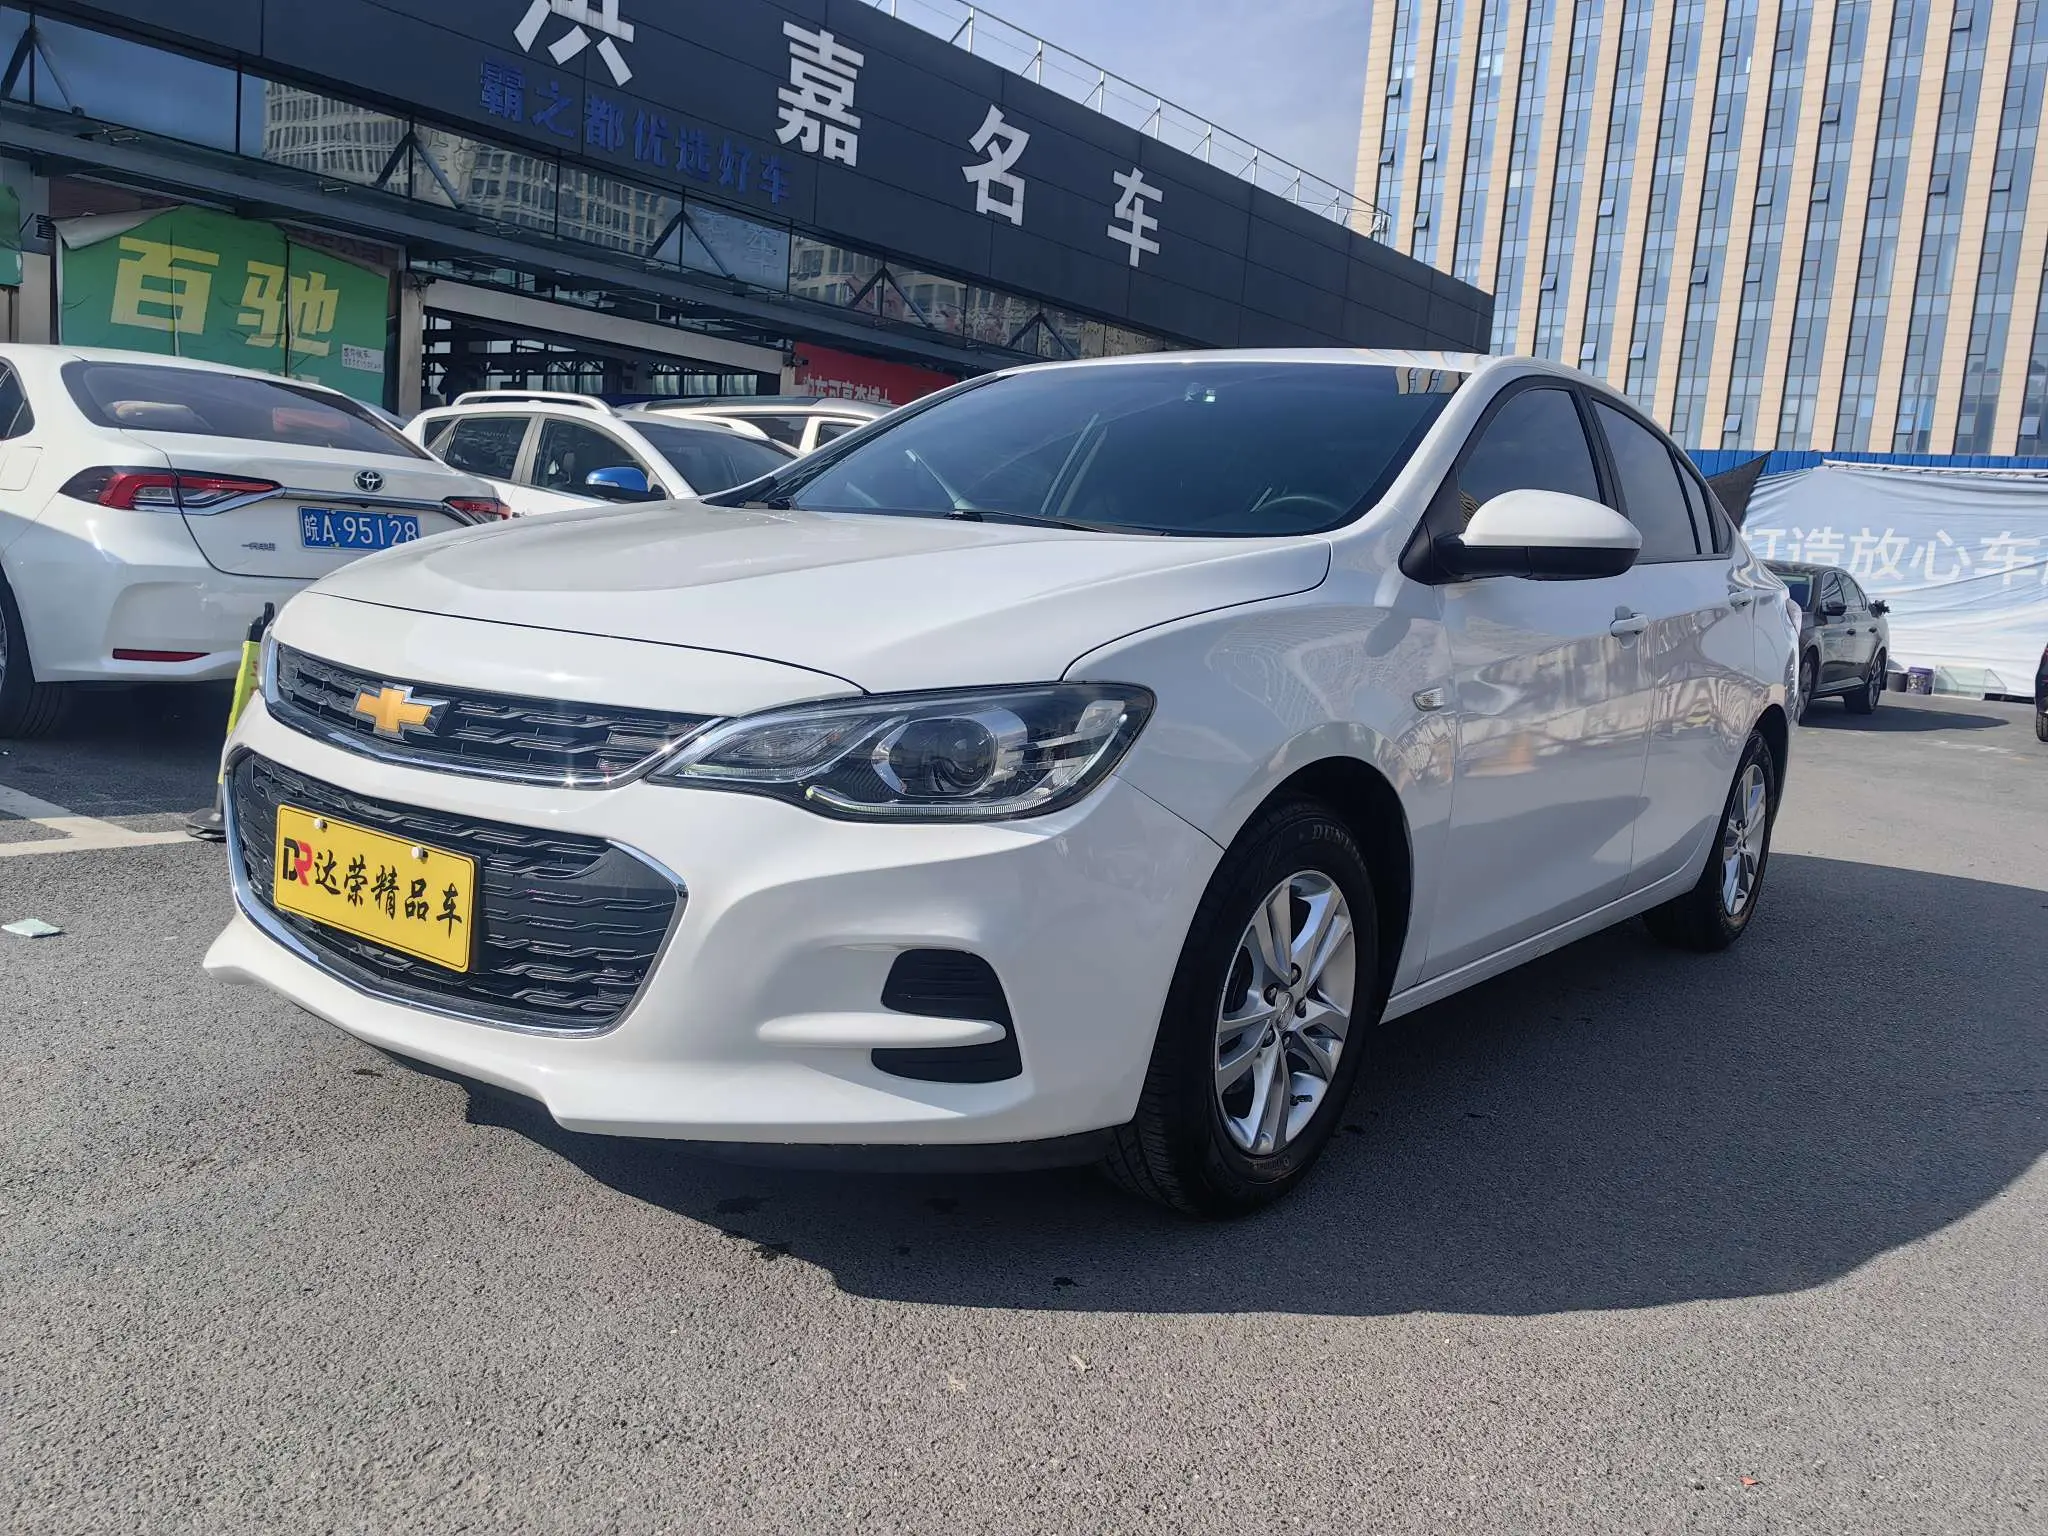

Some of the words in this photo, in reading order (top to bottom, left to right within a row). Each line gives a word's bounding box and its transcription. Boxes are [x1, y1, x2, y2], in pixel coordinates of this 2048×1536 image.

[110, 237, 339, 357] 百驰
[1740, 526, 2048, 586] 打造放心车
[313, 849, 463, 938] 达荣精品车
